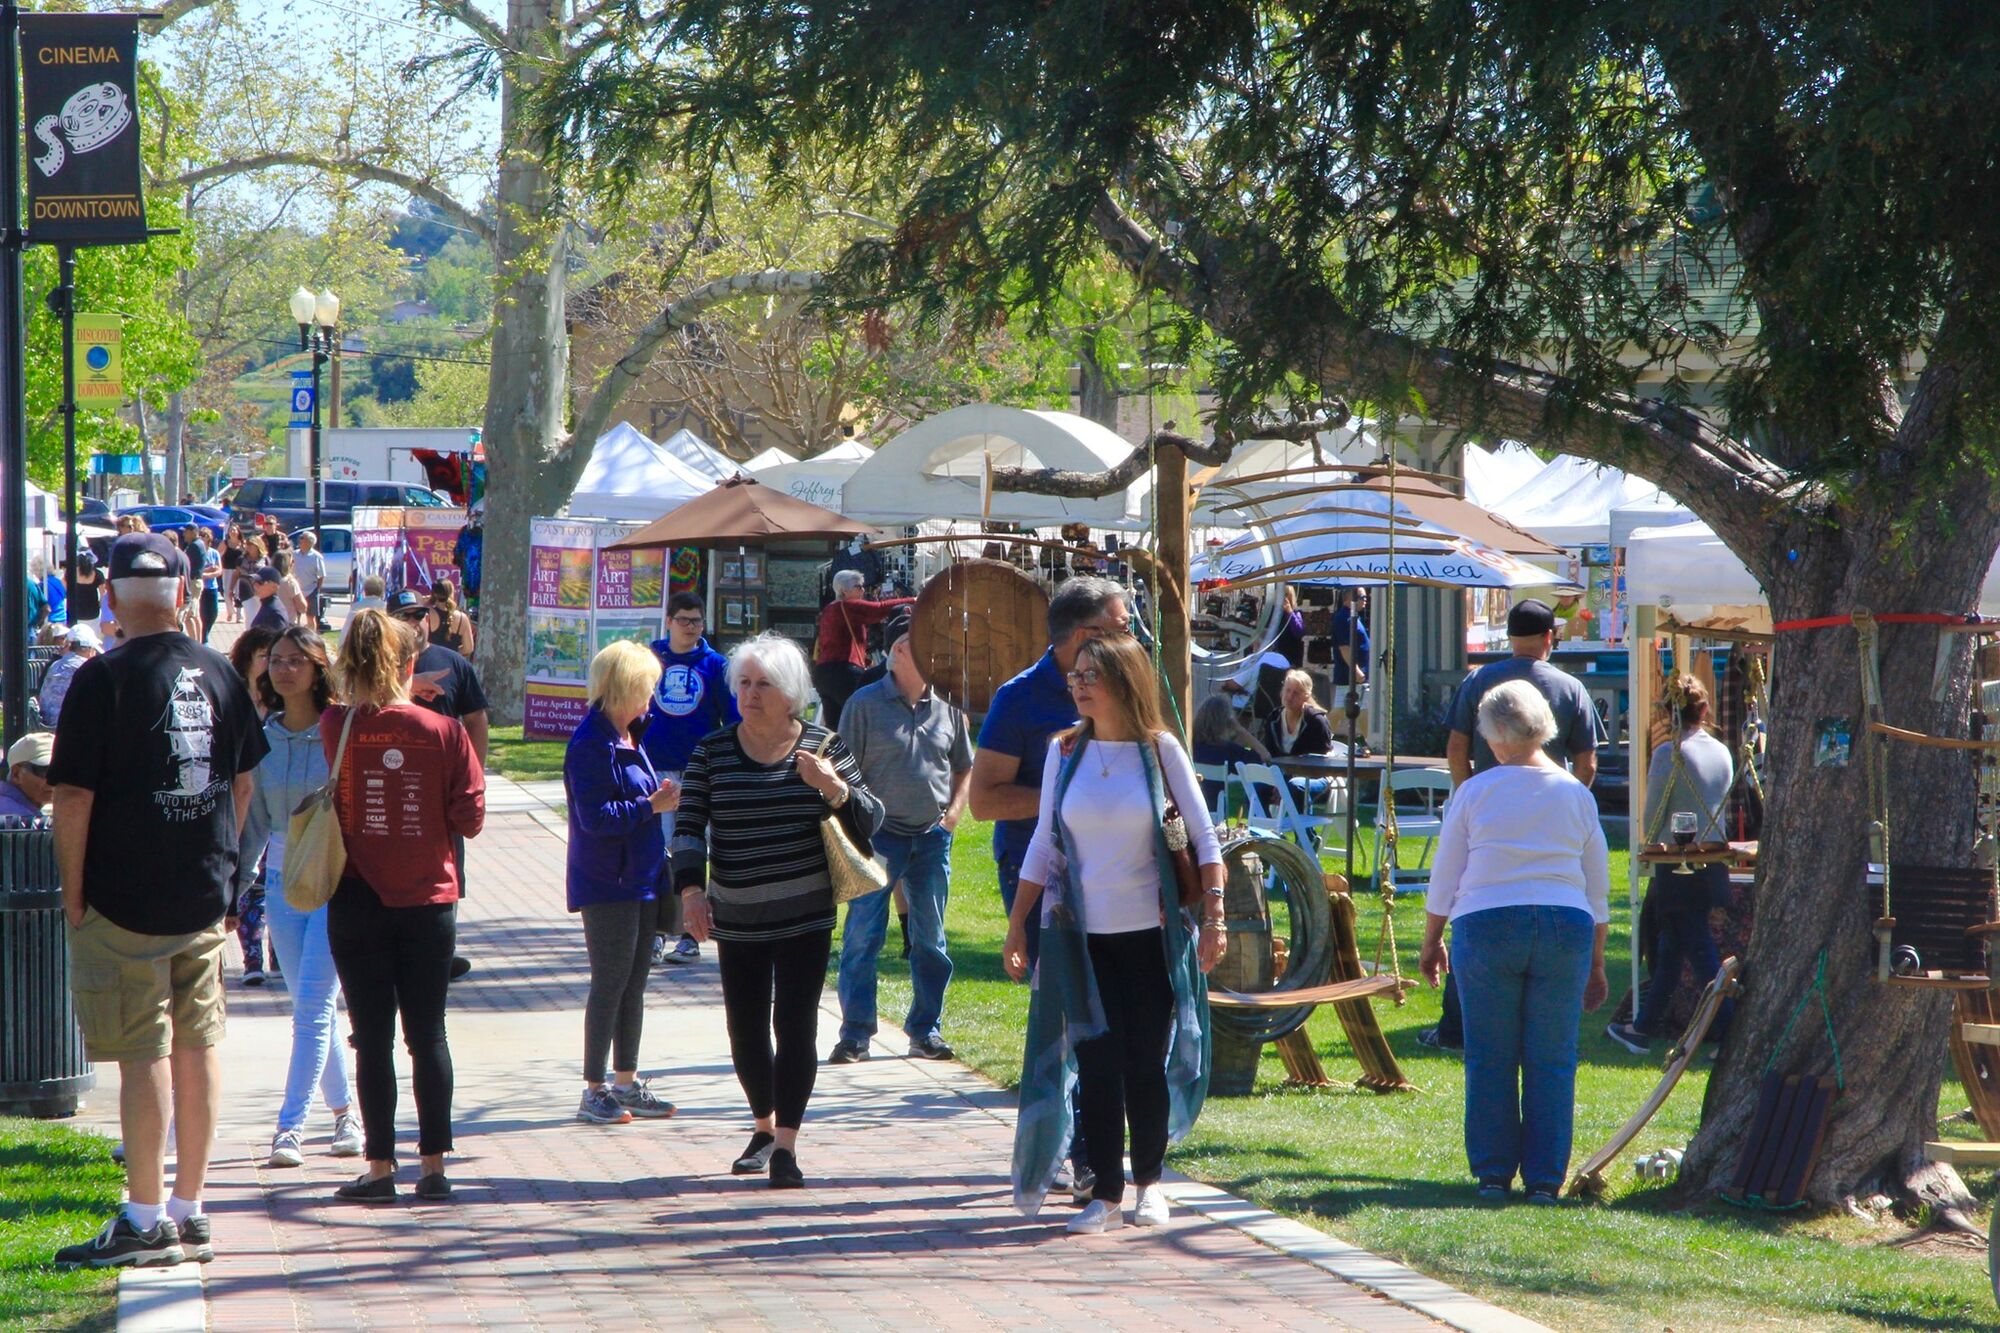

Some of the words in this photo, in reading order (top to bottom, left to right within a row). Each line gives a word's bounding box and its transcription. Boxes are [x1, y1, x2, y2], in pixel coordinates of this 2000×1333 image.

[38, 47, 120, 64] CINEMA
[35, 201, 140, 219] DOWNTOWN
[77, 329, 120, 341] DISCOVER
[77, 383, 121, 397] DOWNTOWN
[791, 480, 835, 503] Jeffrey
[534, 523, 594, 537] CASTORO
[535, 548, 560, 560] Paso
[602, 551, 630, 560] Paso
[533, 562, 558, 582] ART
[600, 565, 629, 583] ART
[545, 583, 557, 593] The
[606, 584, 615, 594] In
[615, 584, 630, 594] The
[532, 593, 557, 606] PARK
[599, 595, 630, 607] PARK
[531, 698, 550, 708] Late
[550, 700, 571, 711] April
[573, 701, 582, 709] &
[529, 710, 547, 718] Late
[548, 711, 584, 721] October
[534, 720, 557, 731] Every
[558, 722, 578, 731] Year
[359, 733, 392, 742] RACE
[154, 791, 180, 807] INTO
[183, 795, 203, 807] THE
[203, 780, 230, 801] DEPTHS
[172, 808, 198, 822] THE
[201, 800, 217, 816] SEA
